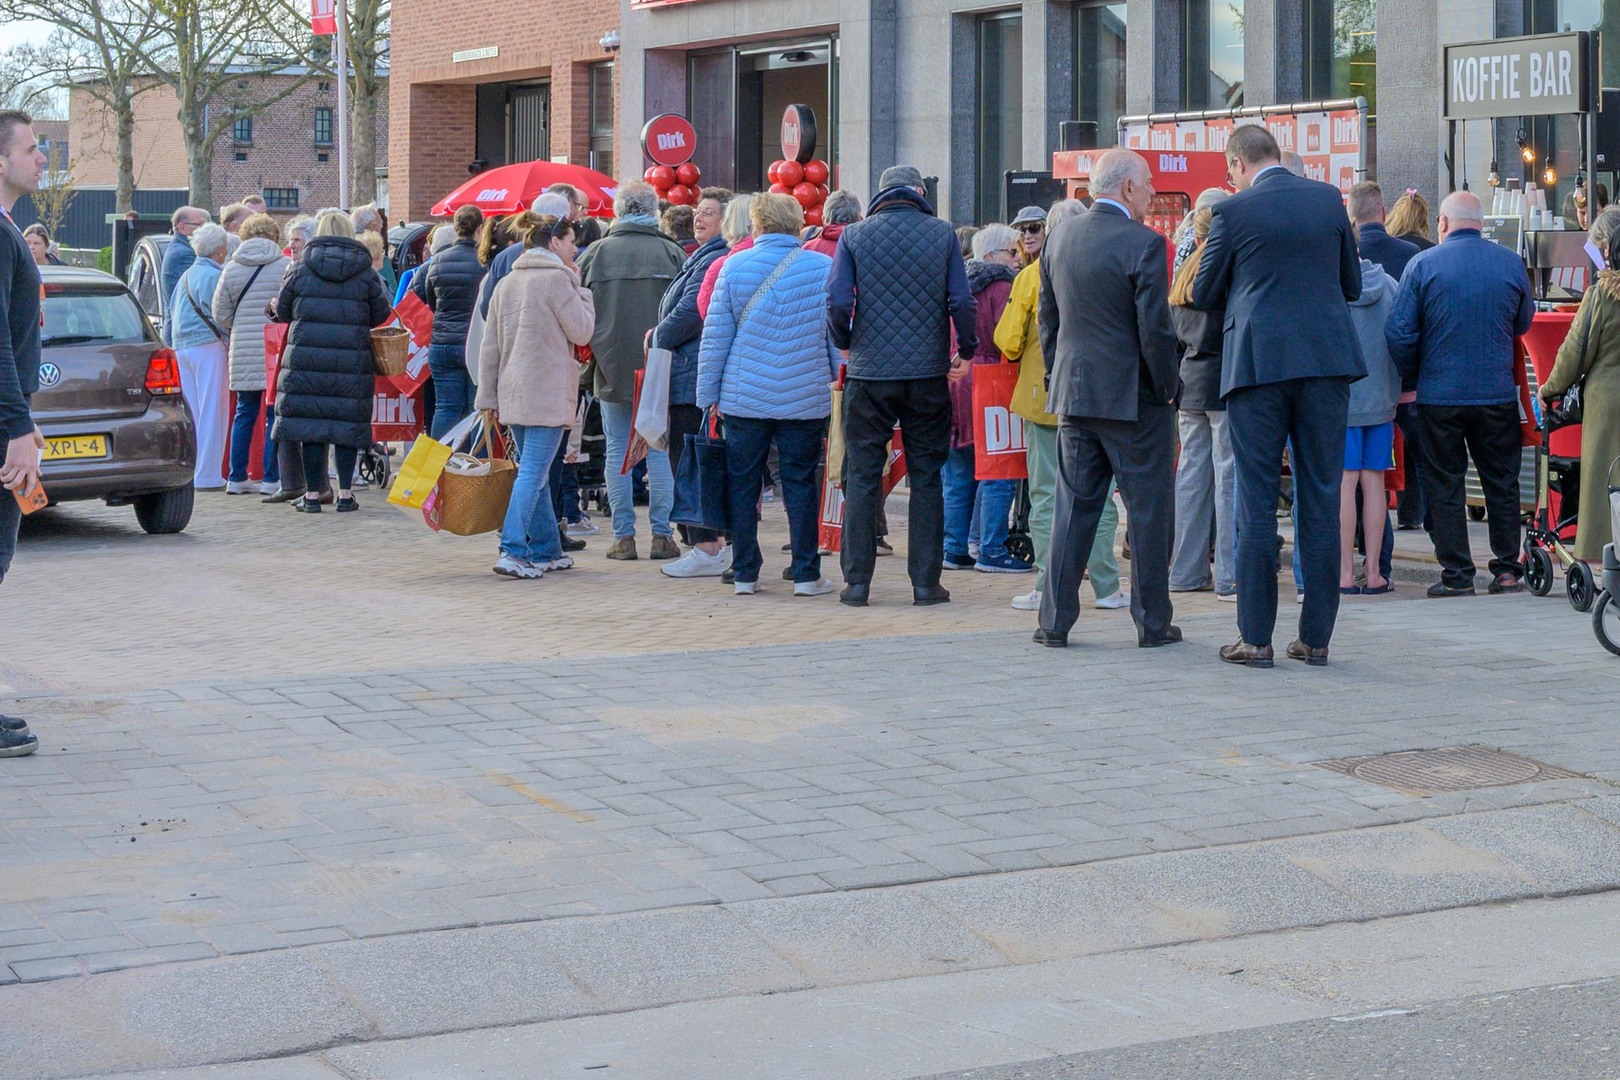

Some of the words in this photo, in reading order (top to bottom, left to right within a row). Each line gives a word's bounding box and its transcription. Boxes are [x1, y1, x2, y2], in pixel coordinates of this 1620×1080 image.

[1453, 54, 1520, 103] KOFFIE
[1530, 50, 1571, 97] BAR
[784, 122, 798, 146] Dirk
[1151, 130, 1172, 151] Dirk
[1334, 117, 1359, 143] Dirk
[657, 131, 686, 151] Dirk
[1159, 153, 1188, 172] Dirk
[476, 188, 509, 201] Dirk
